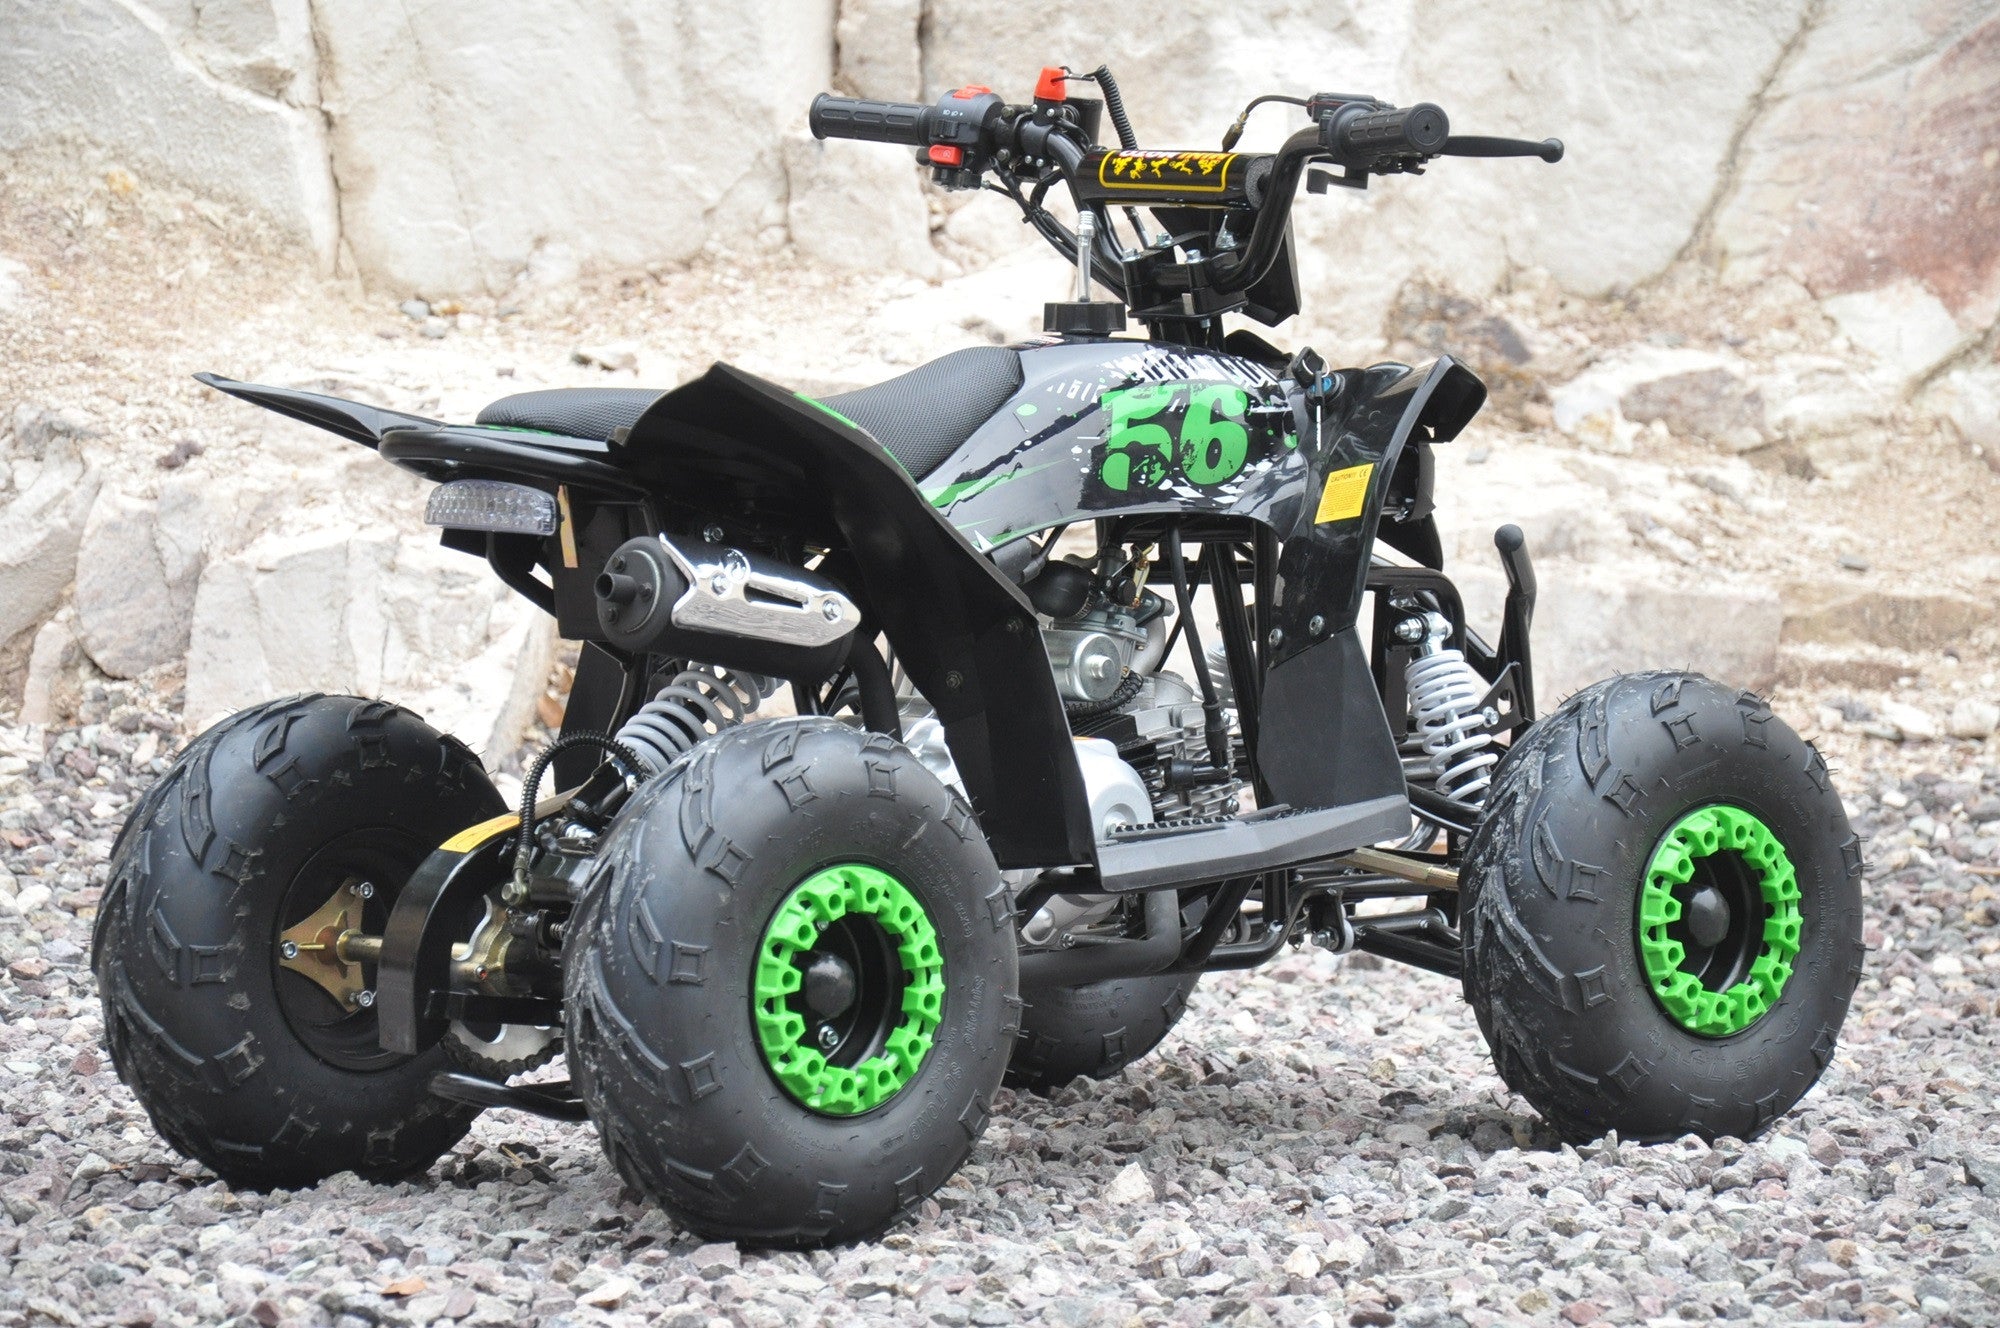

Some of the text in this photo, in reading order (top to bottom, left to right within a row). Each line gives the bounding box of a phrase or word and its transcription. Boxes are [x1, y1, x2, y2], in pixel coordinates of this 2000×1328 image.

[1101, 382, 1249, 491] 56
[944, 1061, 963, 1089] SU
[908, 1089, 948, 1141] TONG
